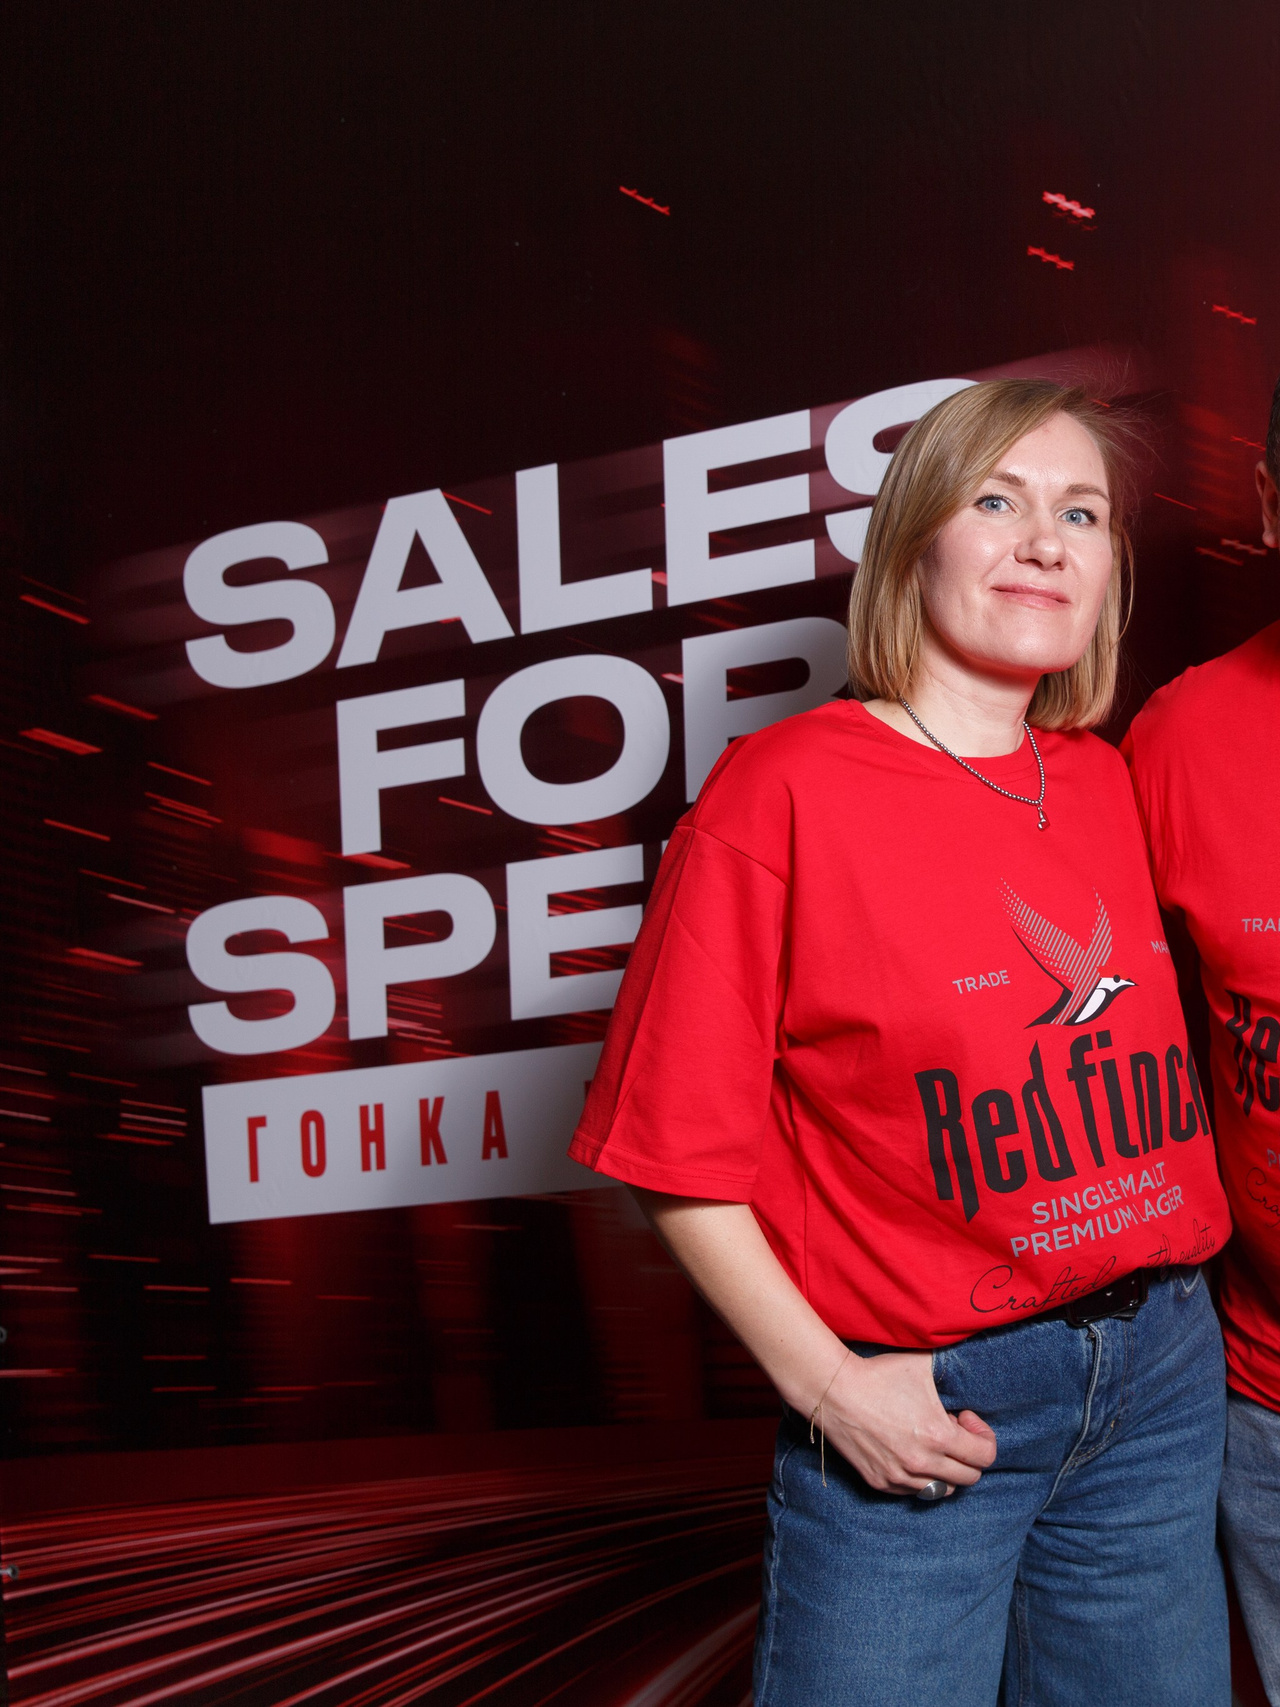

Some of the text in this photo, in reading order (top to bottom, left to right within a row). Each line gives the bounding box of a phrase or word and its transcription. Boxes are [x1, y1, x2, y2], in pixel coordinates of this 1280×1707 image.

[185, 841, 668, 1056] SPE
[952, 969, 1011, 995] TRADE
[247, 1090, 509, 1183] ГОНКА
[914, 1039, 1078, 1222] Red
[1010, 1185, 1185, 1258] PREMIUM LAGER
[1031, 1162, 1165, 1225] SINGLE MALT
